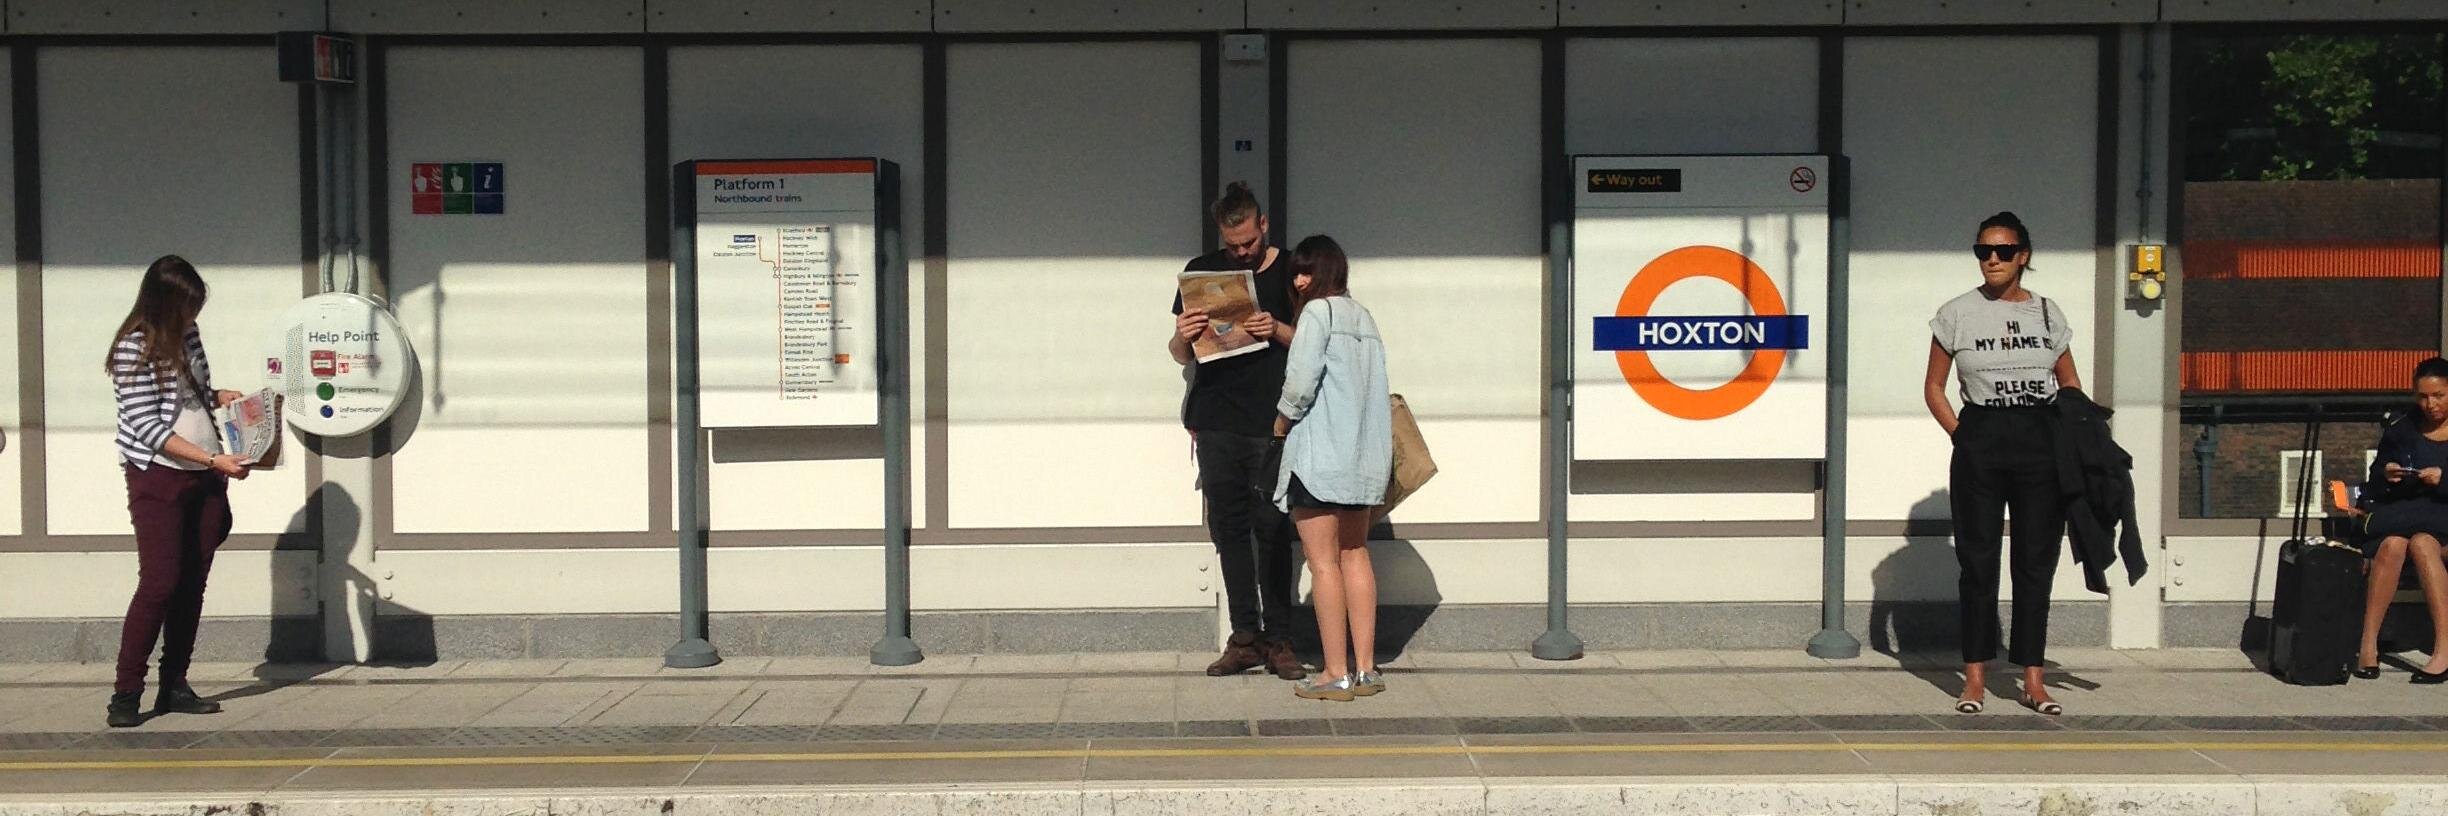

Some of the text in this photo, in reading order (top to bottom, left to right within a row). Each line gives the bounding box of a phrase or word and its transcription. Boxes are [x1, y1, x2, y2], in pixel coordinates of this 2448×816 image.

[714, 178, 785, 190] Platform 1
[1606, 174, 1664, 187] Way out
[714, 193, 803, 203] Northbound trains
[1639, 321, 1765, 345] HOXTON
[2006, 320, 2020, 335] HI
[308, 330, 380, 344] Help Point
[1975, 338, 1996, 352] MY
[2001, 336, 2041, 351] NAME
[1995, 380, 2046, 396] PLEASE
